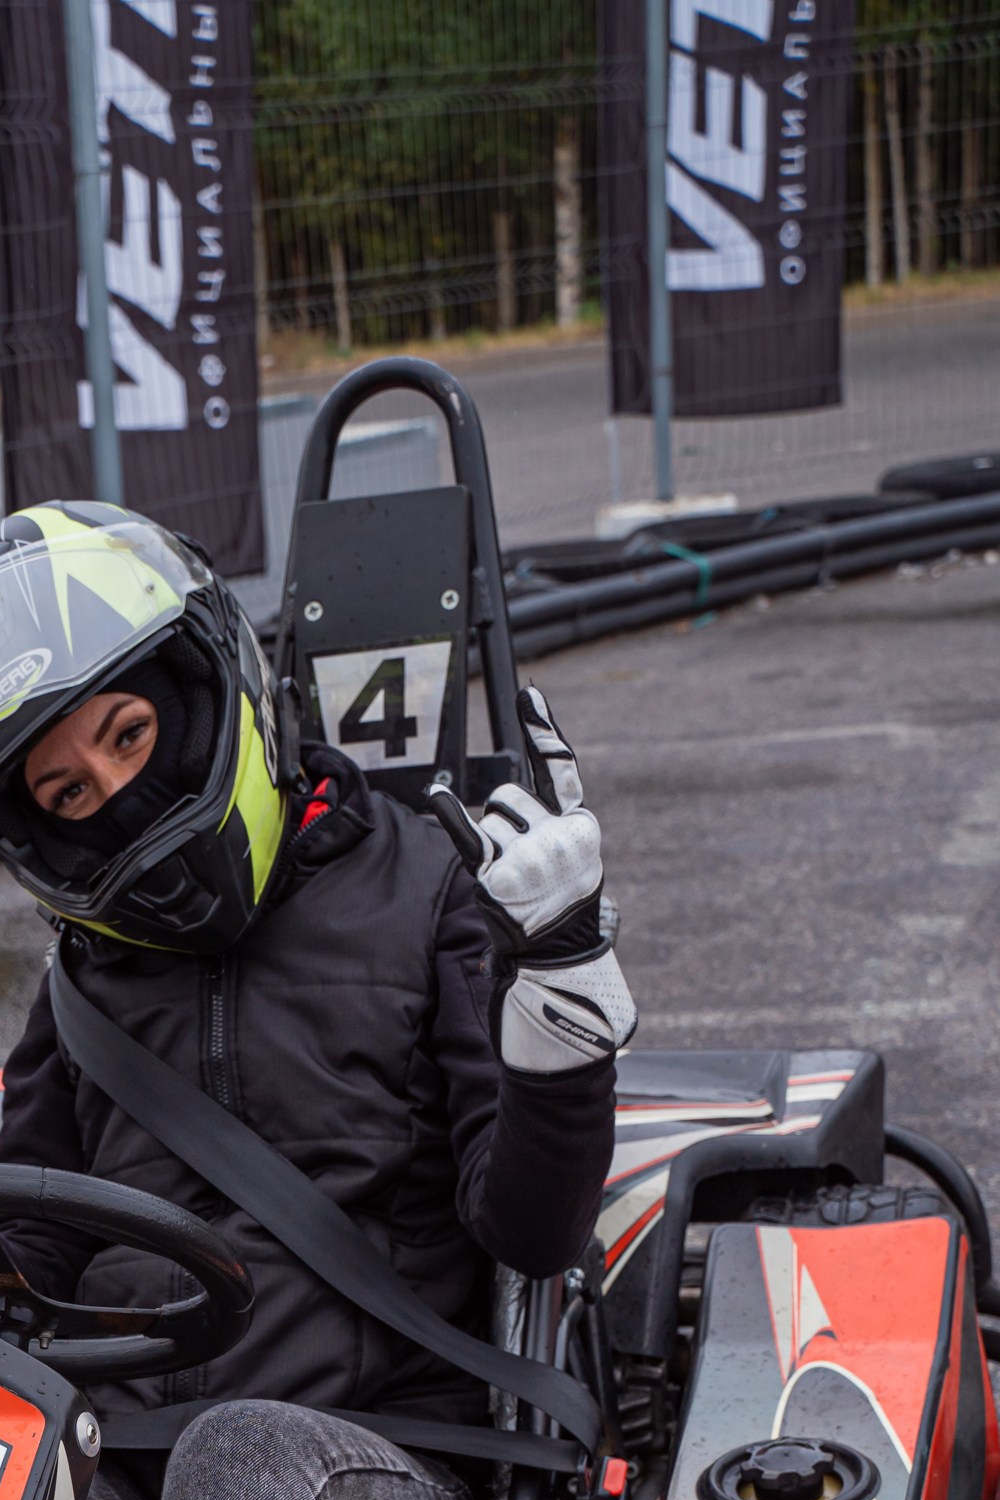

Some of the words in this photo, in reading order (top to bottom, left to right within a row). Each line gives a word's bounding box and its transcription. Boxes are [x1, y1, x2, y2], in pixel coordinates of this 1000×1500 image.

[77, 0, 187, 430] VET
[338, 657, 417, 759] 4
[554, 1018, 599, 1043] SHIMA
